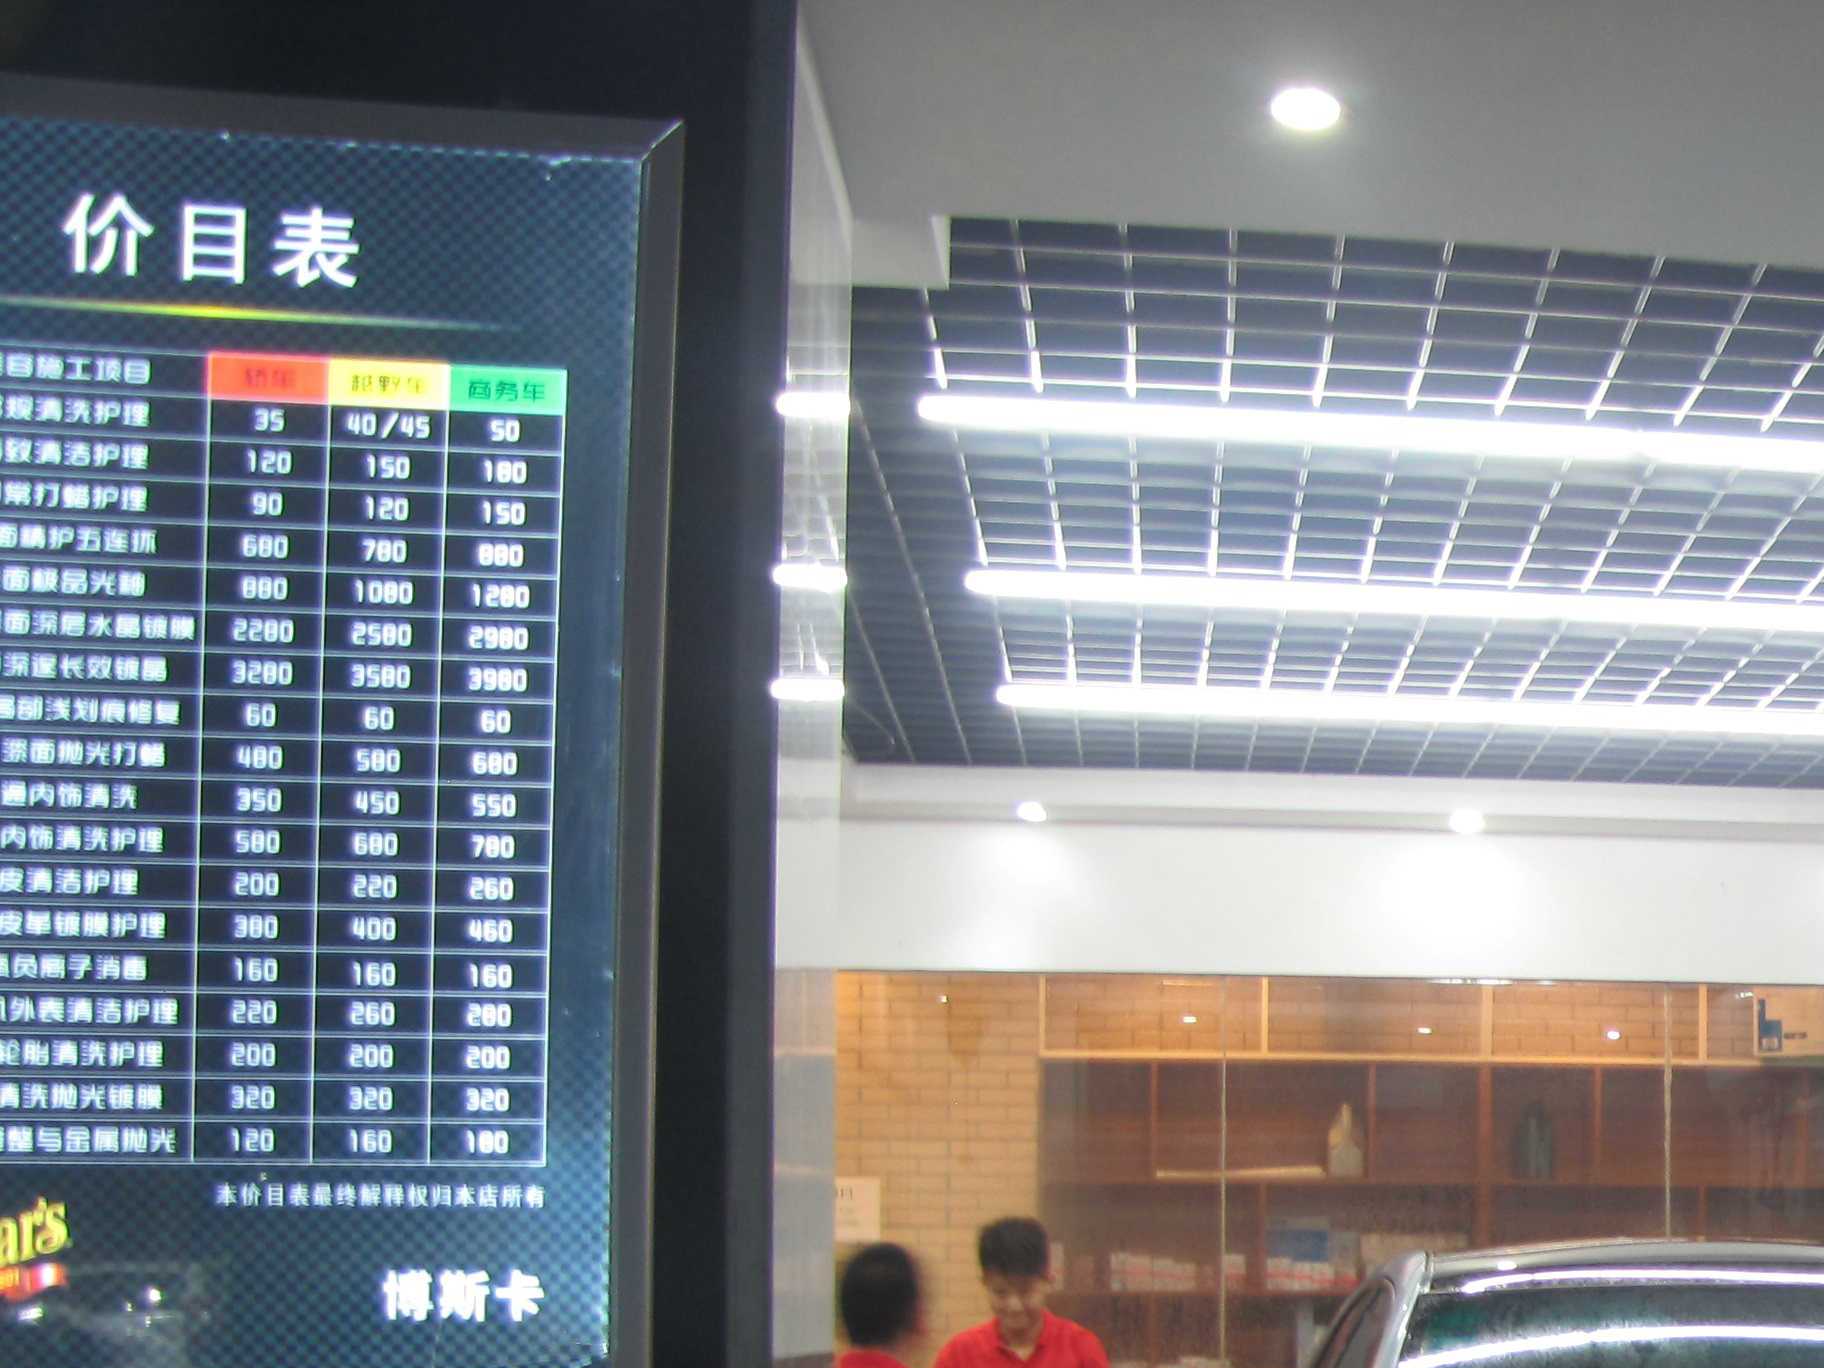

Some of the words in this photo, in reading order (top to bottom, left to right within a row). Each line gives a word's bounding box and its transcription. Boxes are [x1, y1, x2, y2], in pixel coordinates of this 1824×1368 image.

[62, 193, 361, 288] 价目表
[467, 379, 545, 402] 商务车
[254, 408, 285, 432] 35
[347, 411, 430, 439] 40/45
[490, 420, 520, 442] 50
[248, 450, 292, 475] 120
[367, 455, 410, 479] 150
[484, 460, 527, 484] 180
[252, 492, 283, 516] 90
[366, 497, 408, 521] 120
[483, 502, 525, 525] 150
[242, 534, 288, 559] 680
[362, 539, 407, 563] 780
[478, 543, 523, 567] 880
[242, 576, 288, 600] 880
[355, 580, 413, 604] 1080
[473, 584, 530, 607] 1280
[234, 618, 294, 642] 2280
[352, 622, 412, 647] 2580
[468, 626, 528, 650] 2980
[233, 661, 292, 685] 3280
[352, 664, 411, 688] 3580
[469, 668, 527, 691] 3980
[245, 703, 276, 727] 60
[364, 706, 394, 730] 60
[481, 710, 511, 733] 60
[237, 745, 283, 769] 480
[356, 749, 400, 772] 580
[473, 752, 517, 775] 680
[237, 788, 282, 811] 350
[355, 791, 399, 814] 450
[472, 794, 516, 817] 550
[236, 830, 281, 853] 580
[354, 833, 398, 856] 680
[472, 835, 514, 858] 780
[235, 872, 279, 896] 200
[353, 875, 397, 898] 220
[471, 877, 514, 900] 260
[235, 915, 278, 939] 380
[352, 917, 396, 940] 400
[469, 919, 513, 943] 460
[235, 958, 278, 982] 160
[353, 962, 396, 987] 160
[471, 964, 512, 988] 160
[233, 1000, 277, 1024] 220
[351, 1002, 395, 1026] 260
[468, 1004, 512, 1027] 280
[232, 1043, 276, 1066] 200
[350, 1045, 393, 1068] 200
[466, 1046, 510, 1069] 200
[232, 1086, 275, 1109] 320
[350, 1087, 393, 1110] 320
[466, 1088, 509, 1111] 320
[232, 1128, 274, 1152] 120
[350, 1130, 392, 1153] 160
[467, 1130, 509, 1154] 180
[382, 1269, 546, 1322] 博斯卡
